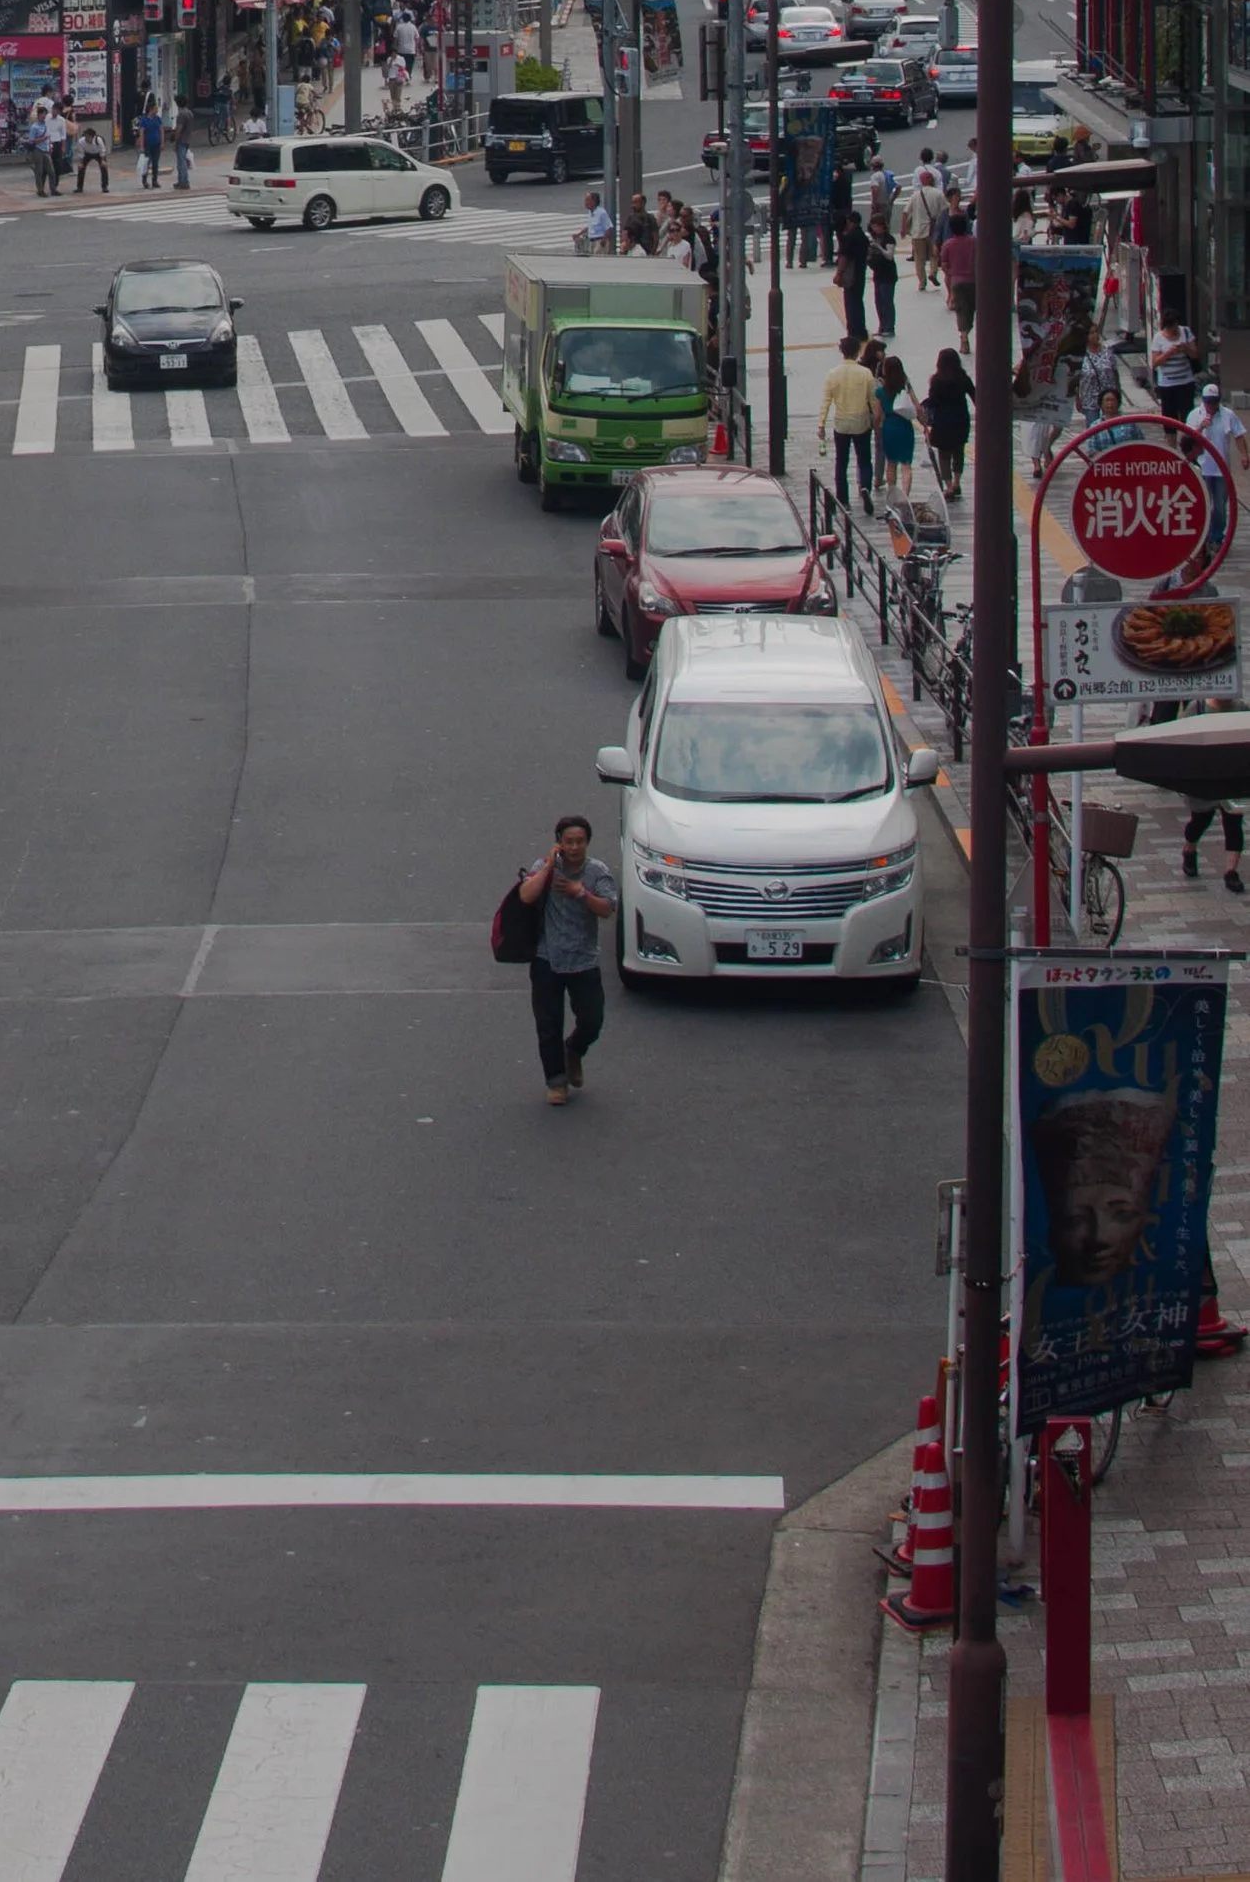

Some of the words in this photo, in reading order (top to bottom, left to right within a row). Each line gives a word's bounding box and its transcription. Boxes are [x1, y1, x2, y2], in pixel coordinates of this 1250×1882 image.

[33, 0, 57, 14] VISA
[1093, 462, 1121, 478] FIRE
[1125, 460, 1183, 477] HYDRANT
[1083, 483, 1197, 539] 消火栓
[1079, 680, 1134, 696] 西郷会館
[1138, 679, 1156, 693] B2
[1045, 965, 1172, 983] ほっとタウンうえの
